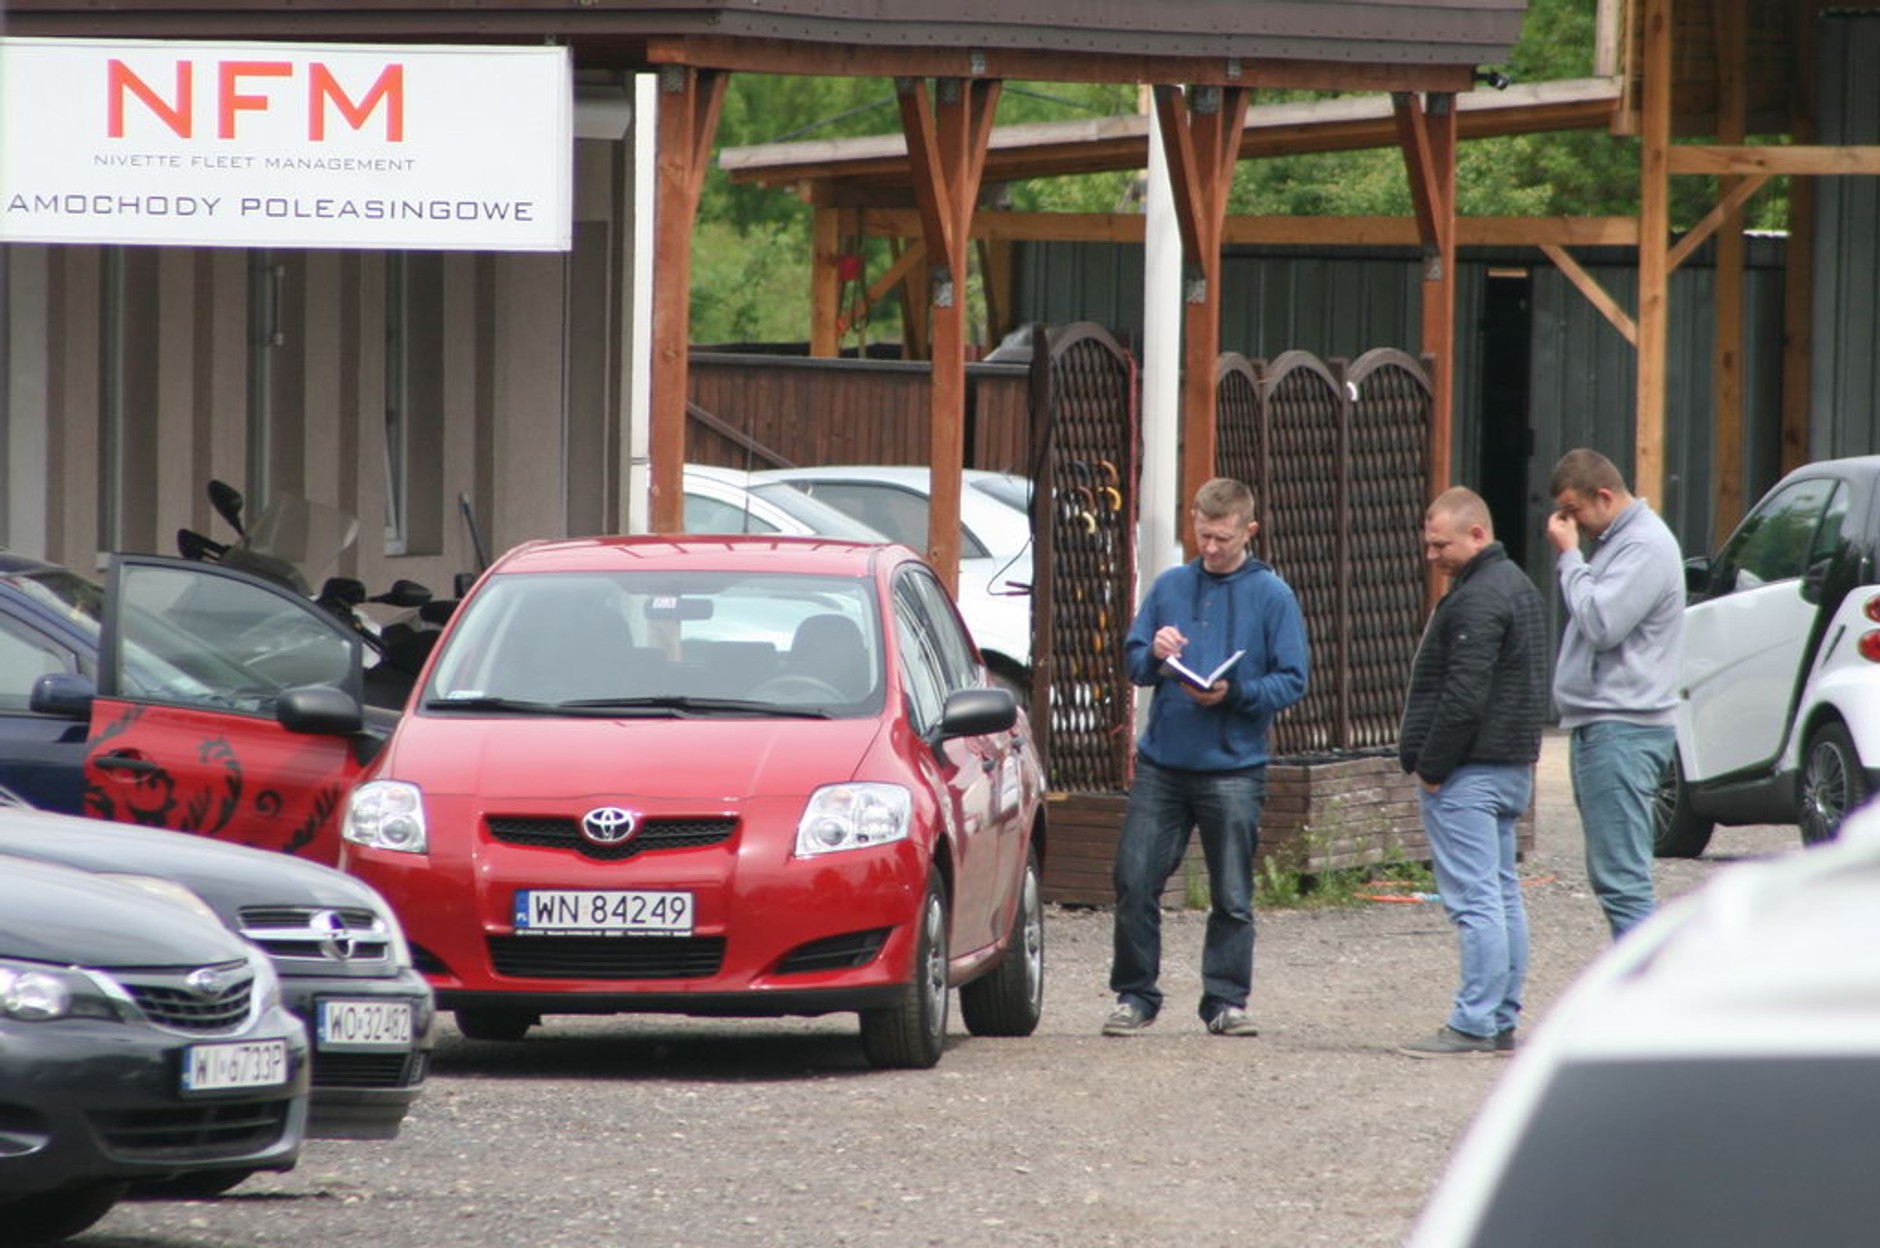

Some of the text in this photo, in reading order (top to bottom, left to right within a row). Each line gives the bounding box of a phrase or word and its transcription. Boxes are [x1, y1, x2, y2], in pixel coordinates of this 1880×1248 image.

[107, 59, 403, 141] NFM
[94, 154, 416, 171] NIVETTE FLEET MANAGEMENT
[7, 194, 534, 221] AMOCHODY POLEASINGOWE
[535, 894, 687, 924] WN 84249
